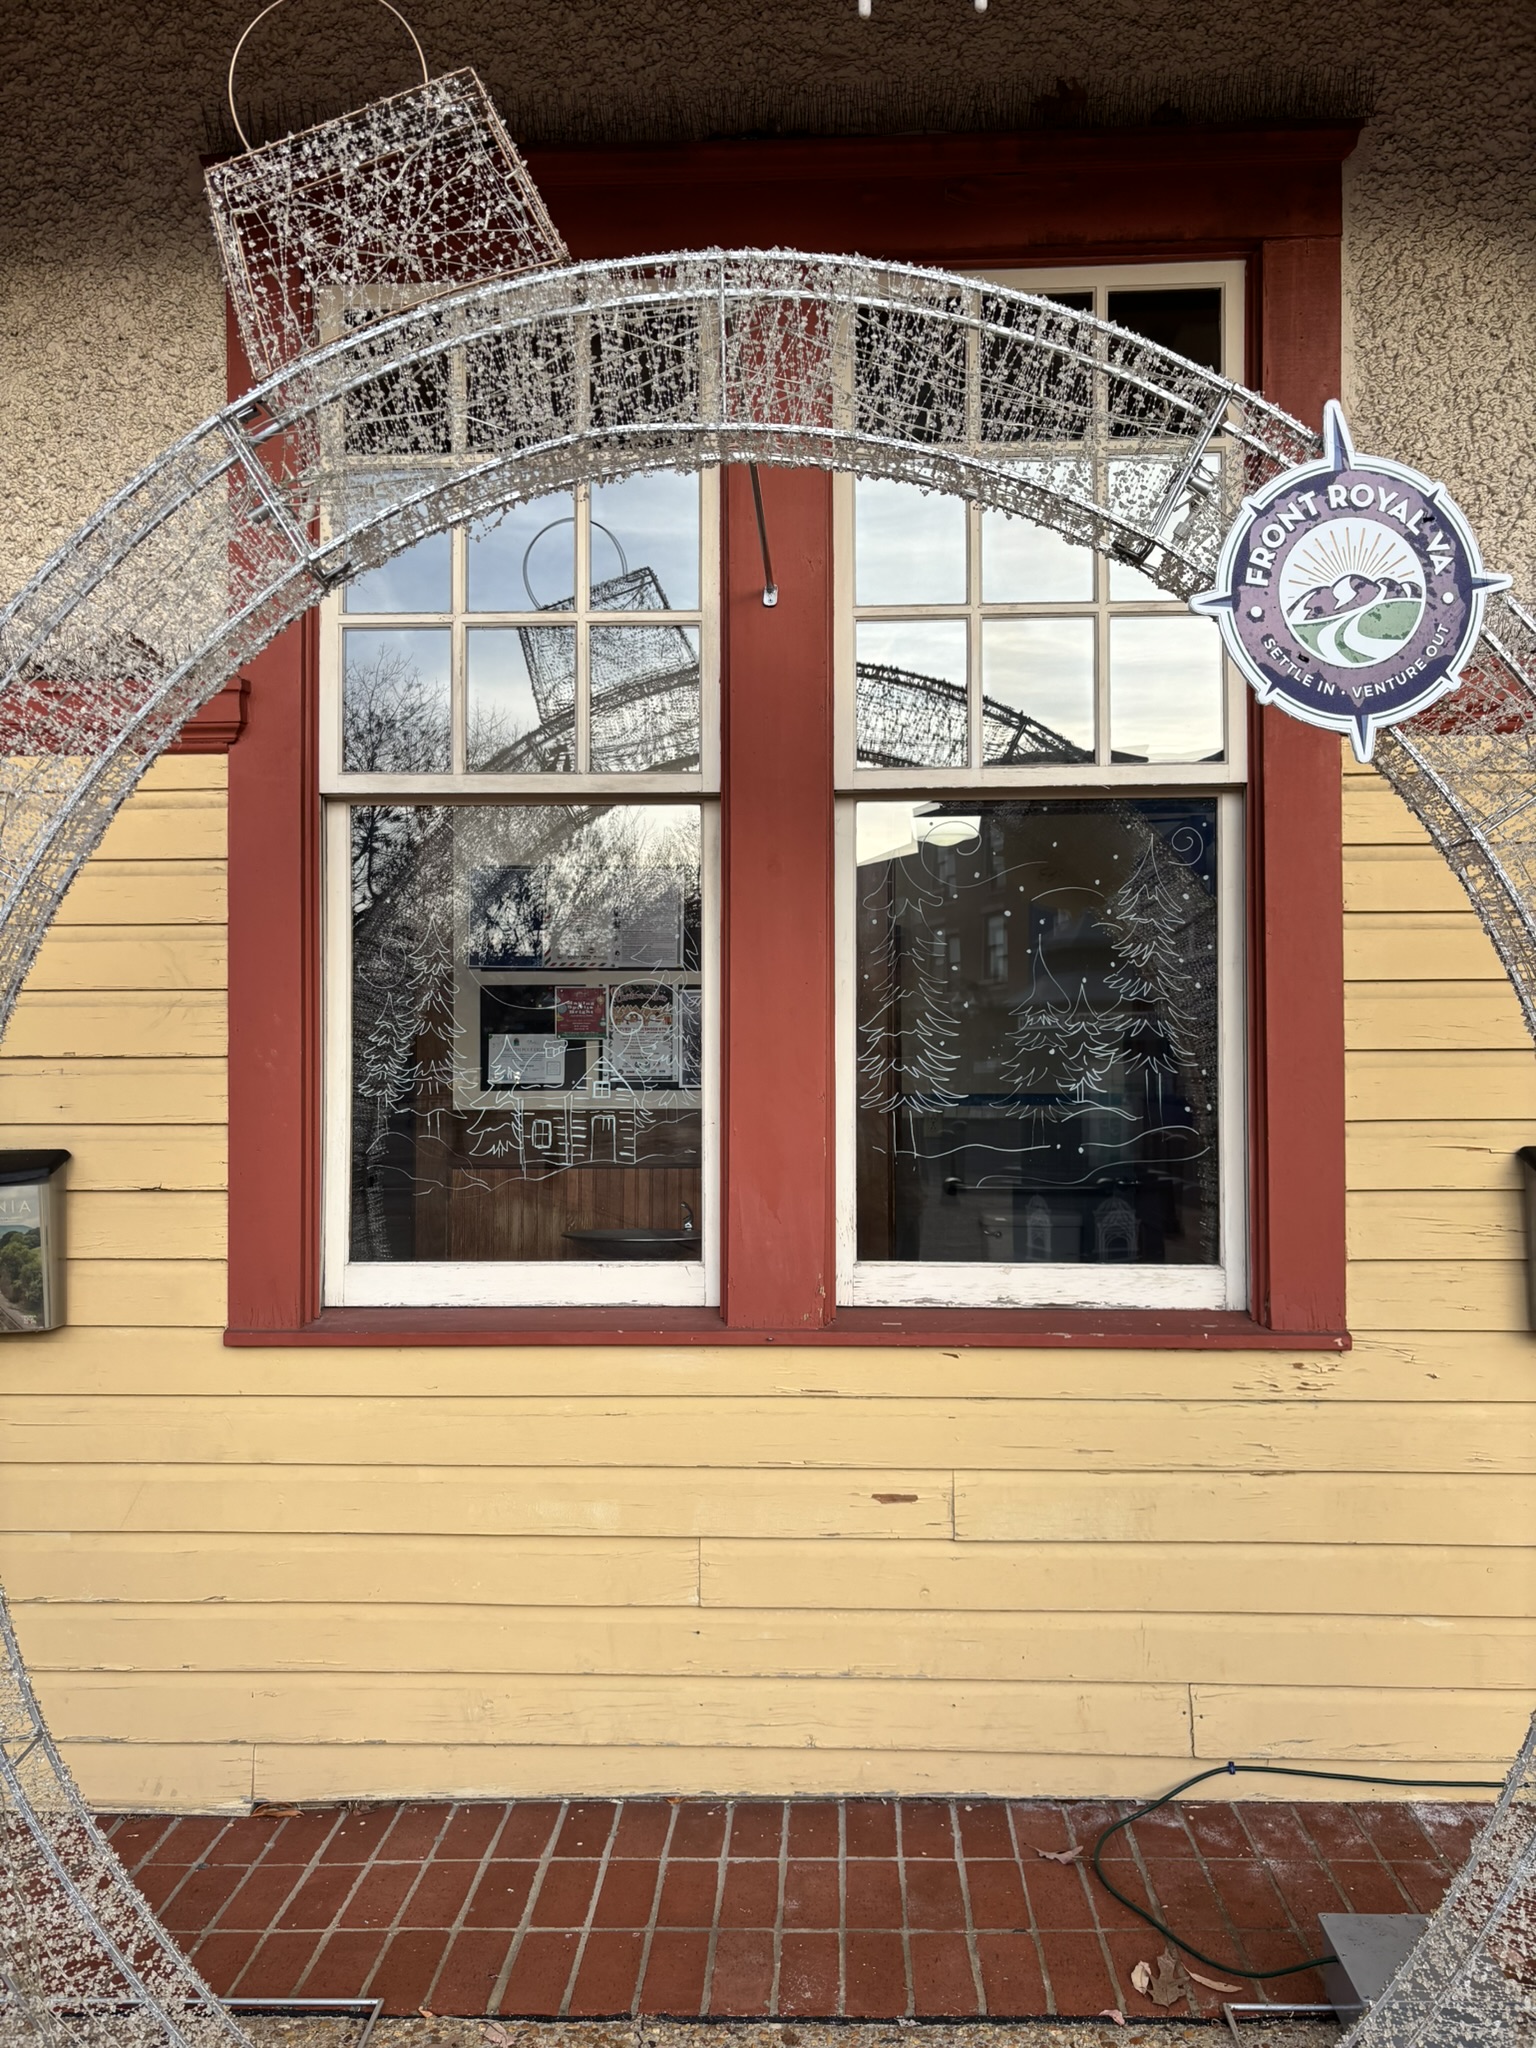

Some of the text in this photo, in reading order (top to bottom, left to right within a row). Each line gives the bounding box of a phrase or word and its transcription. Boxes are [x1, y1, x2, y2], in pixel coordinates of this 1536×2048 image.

[1245, 483, 1454, 587] FRONT ROYAL VA
[1264, 623, 1450, 698] SETTLE IN VENTURE OUT
